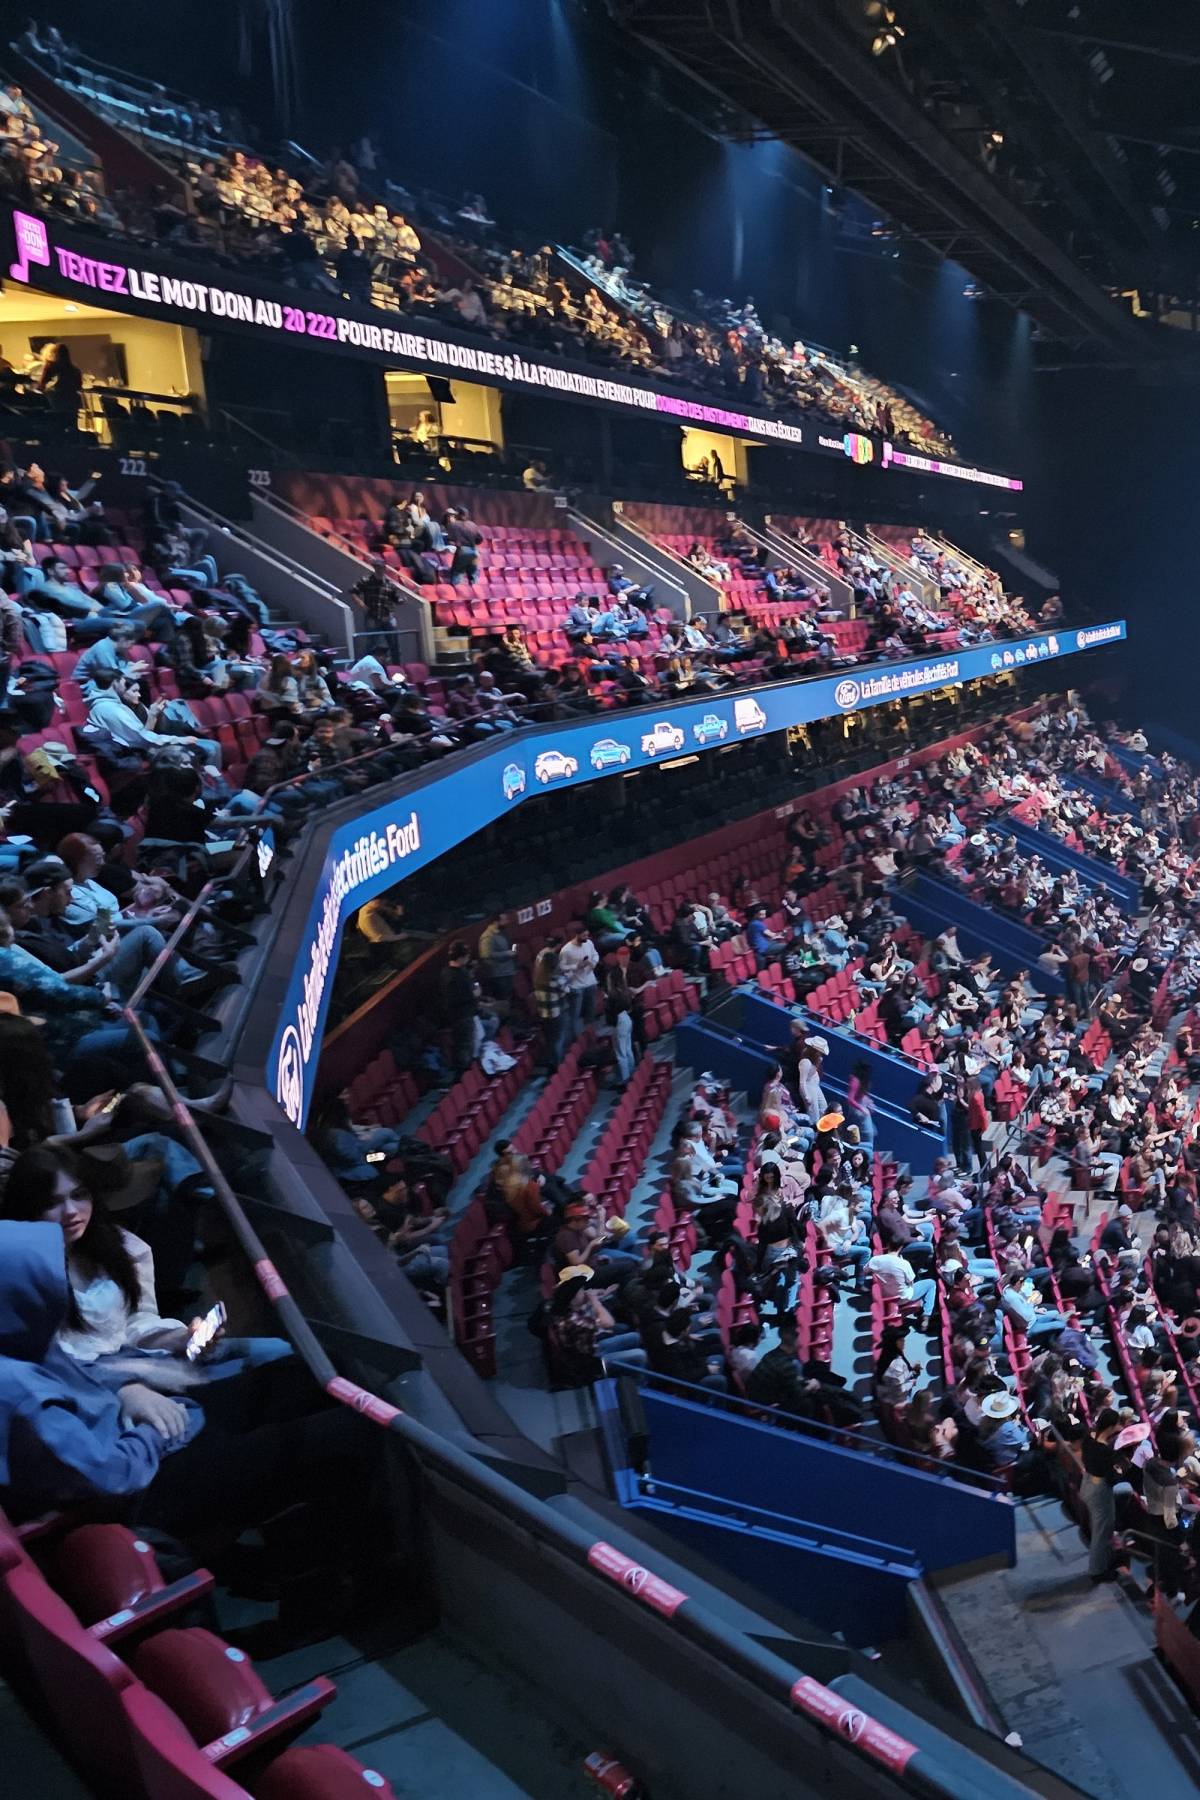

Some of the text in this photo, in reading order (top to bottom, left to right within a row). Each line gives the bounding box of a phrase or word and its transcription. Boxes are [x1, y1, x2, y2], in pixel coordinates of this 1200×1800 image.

[54, 246, 129, 295] TEXTEZ
[128, 268, 161, 302] LE
[160, 276, 208, 312] MOT
[208, 287, 254, 322] DON
[254, 299, 283, 329] AU
[283, 306, 306, 333] 20
[305, 311, 338, 340] 222
[336, 317, 383, 350] POUR
[381, 328, 428, 359] FAIRE
[426, 338, 449, 364] UN
[448, 343, 477, 370] DON
[476, 350, 497, 374] DE
[523, 361, 541, 383] LA
[538, 365, 598, 396] FONDATION
[597, 379, 634, 404] EVENKO
[632, 387, 657, 410] POUR
[119, 458, 147, 476] 222
[248, 470, 271, 485] 223
[386, 812, 421, 863] Ford
